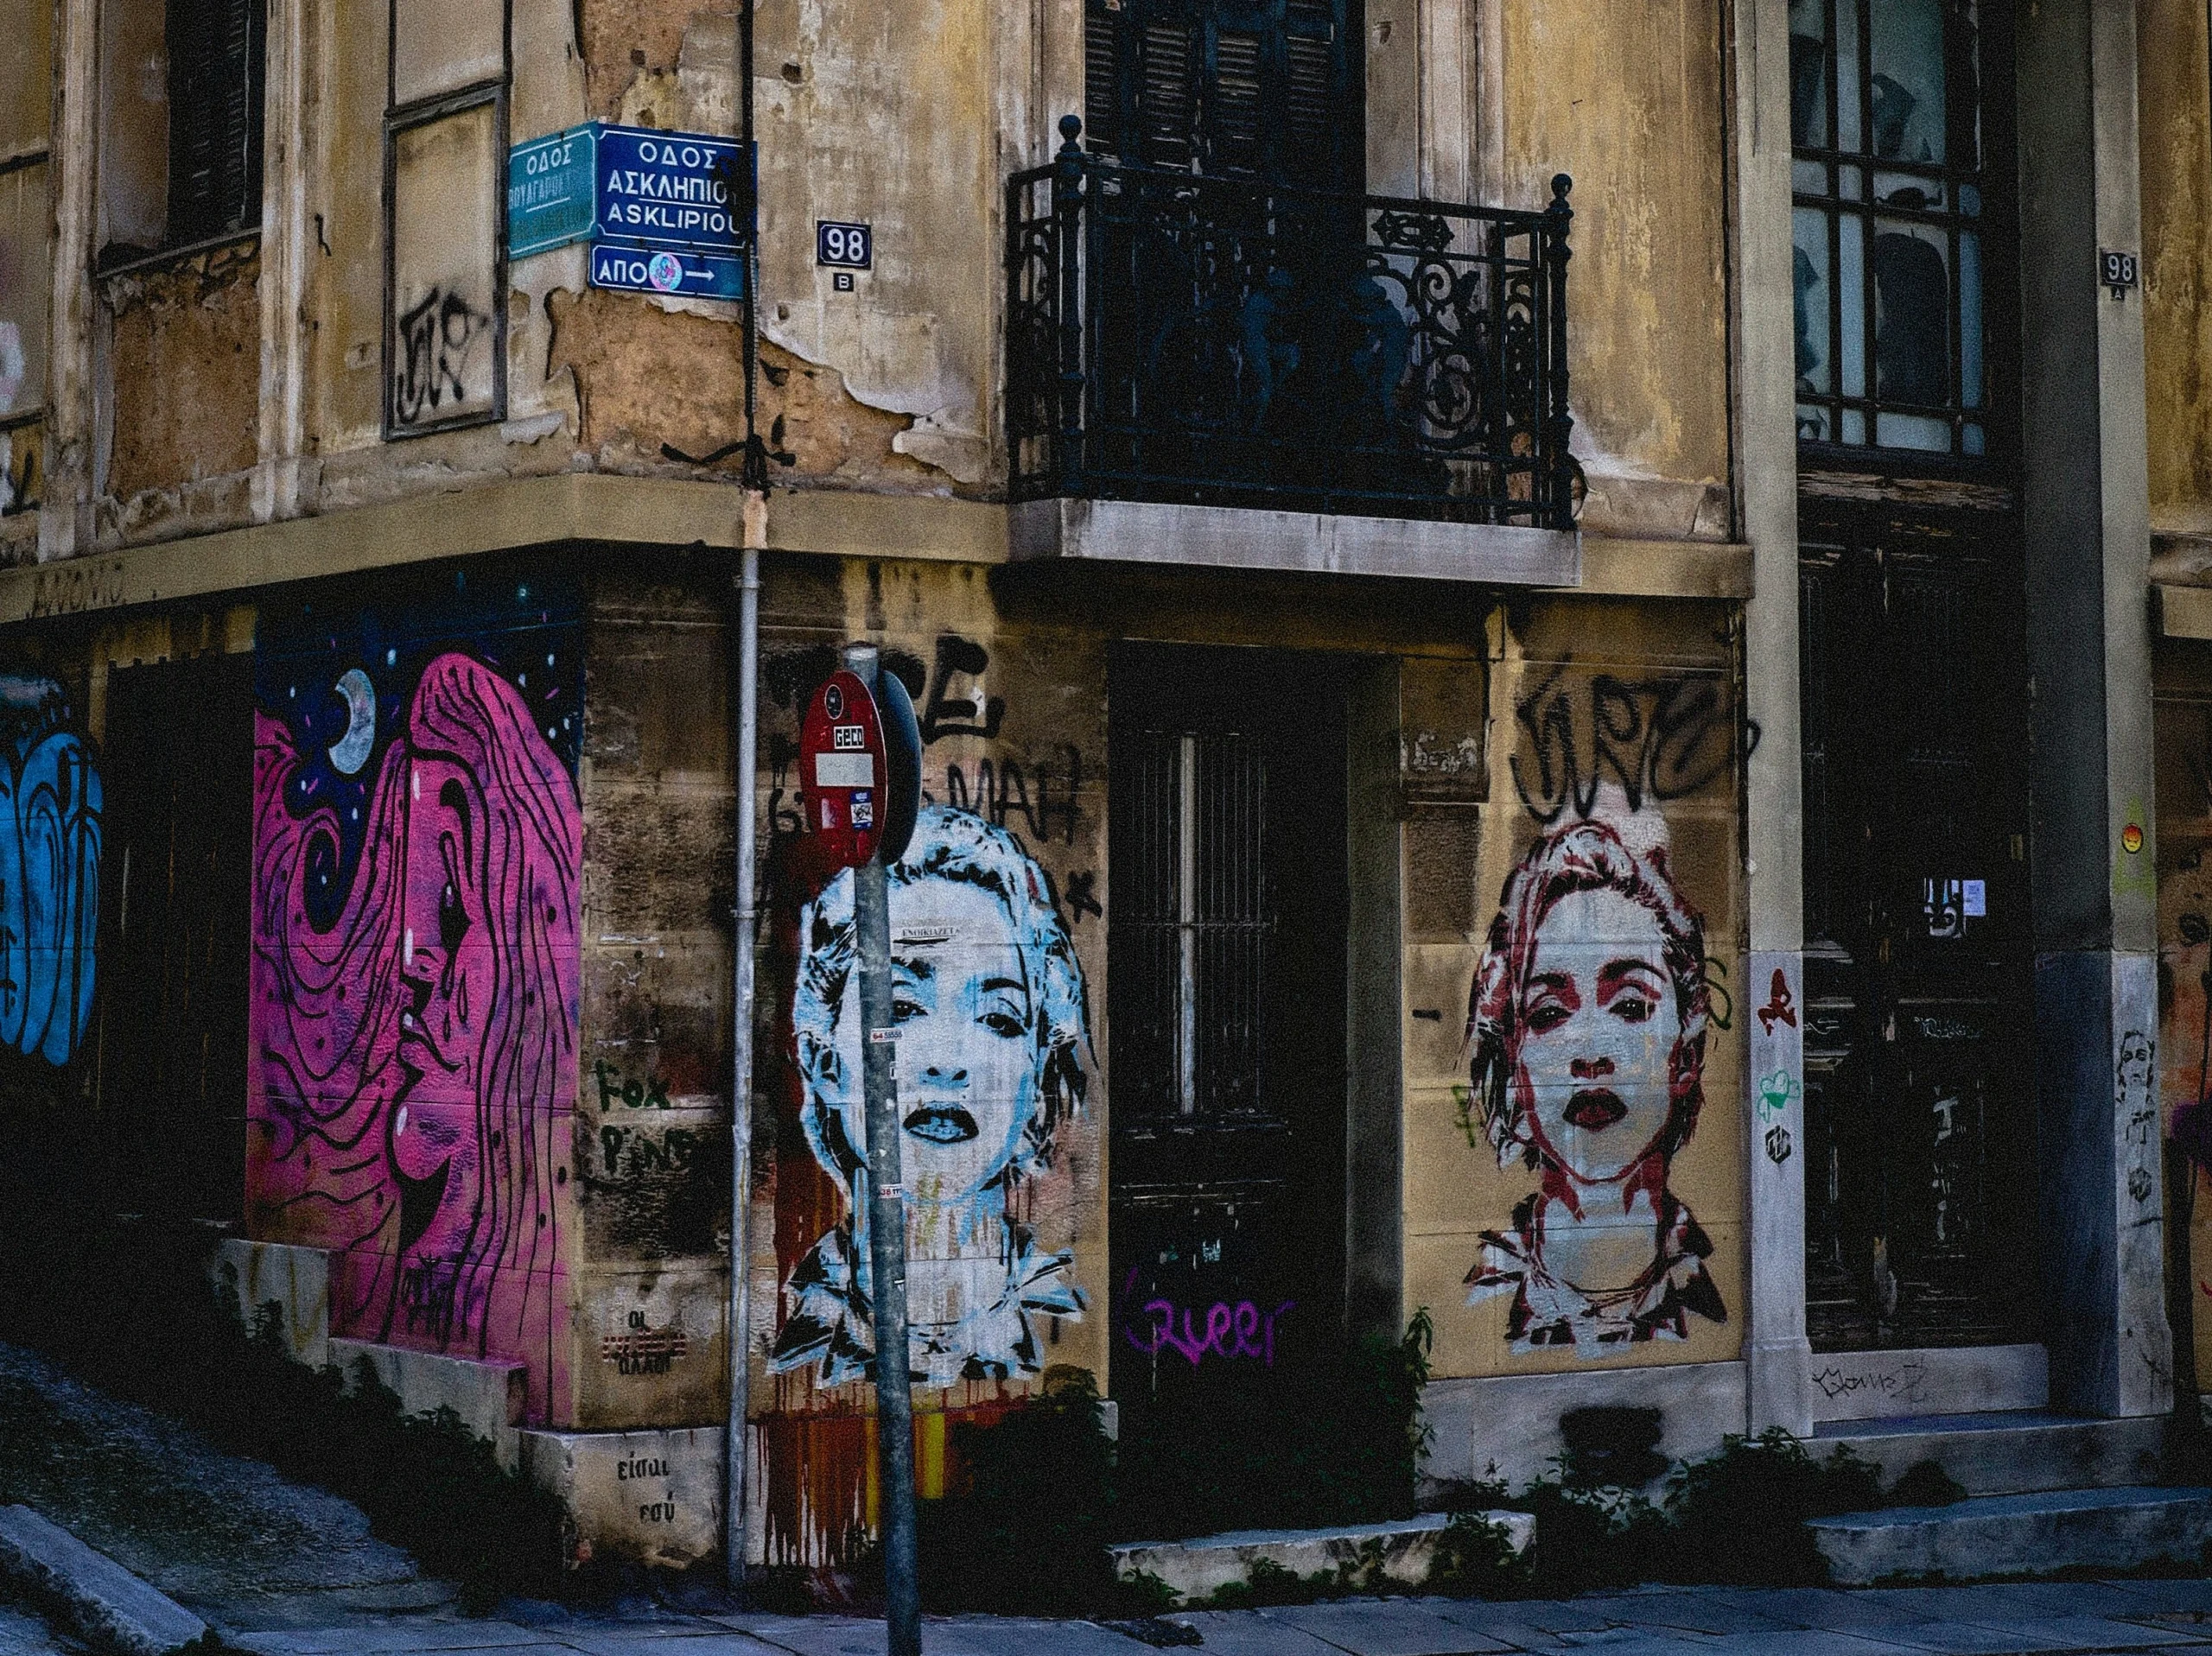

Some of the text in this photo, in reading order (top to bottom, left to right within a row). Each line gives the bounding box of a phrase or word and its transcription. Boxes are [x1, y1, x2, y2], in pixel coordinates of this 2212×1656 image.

[526, 143, 572, 176] ΟΔΟΣ
[638, 141, 718, 169] ΟΔΟΣ
[607, 169, 737, 205] ΑΣΚΛΗΠΙΟ
[827, 228, 864, 262] 98
[2108, 255, 2133, 282] 98
